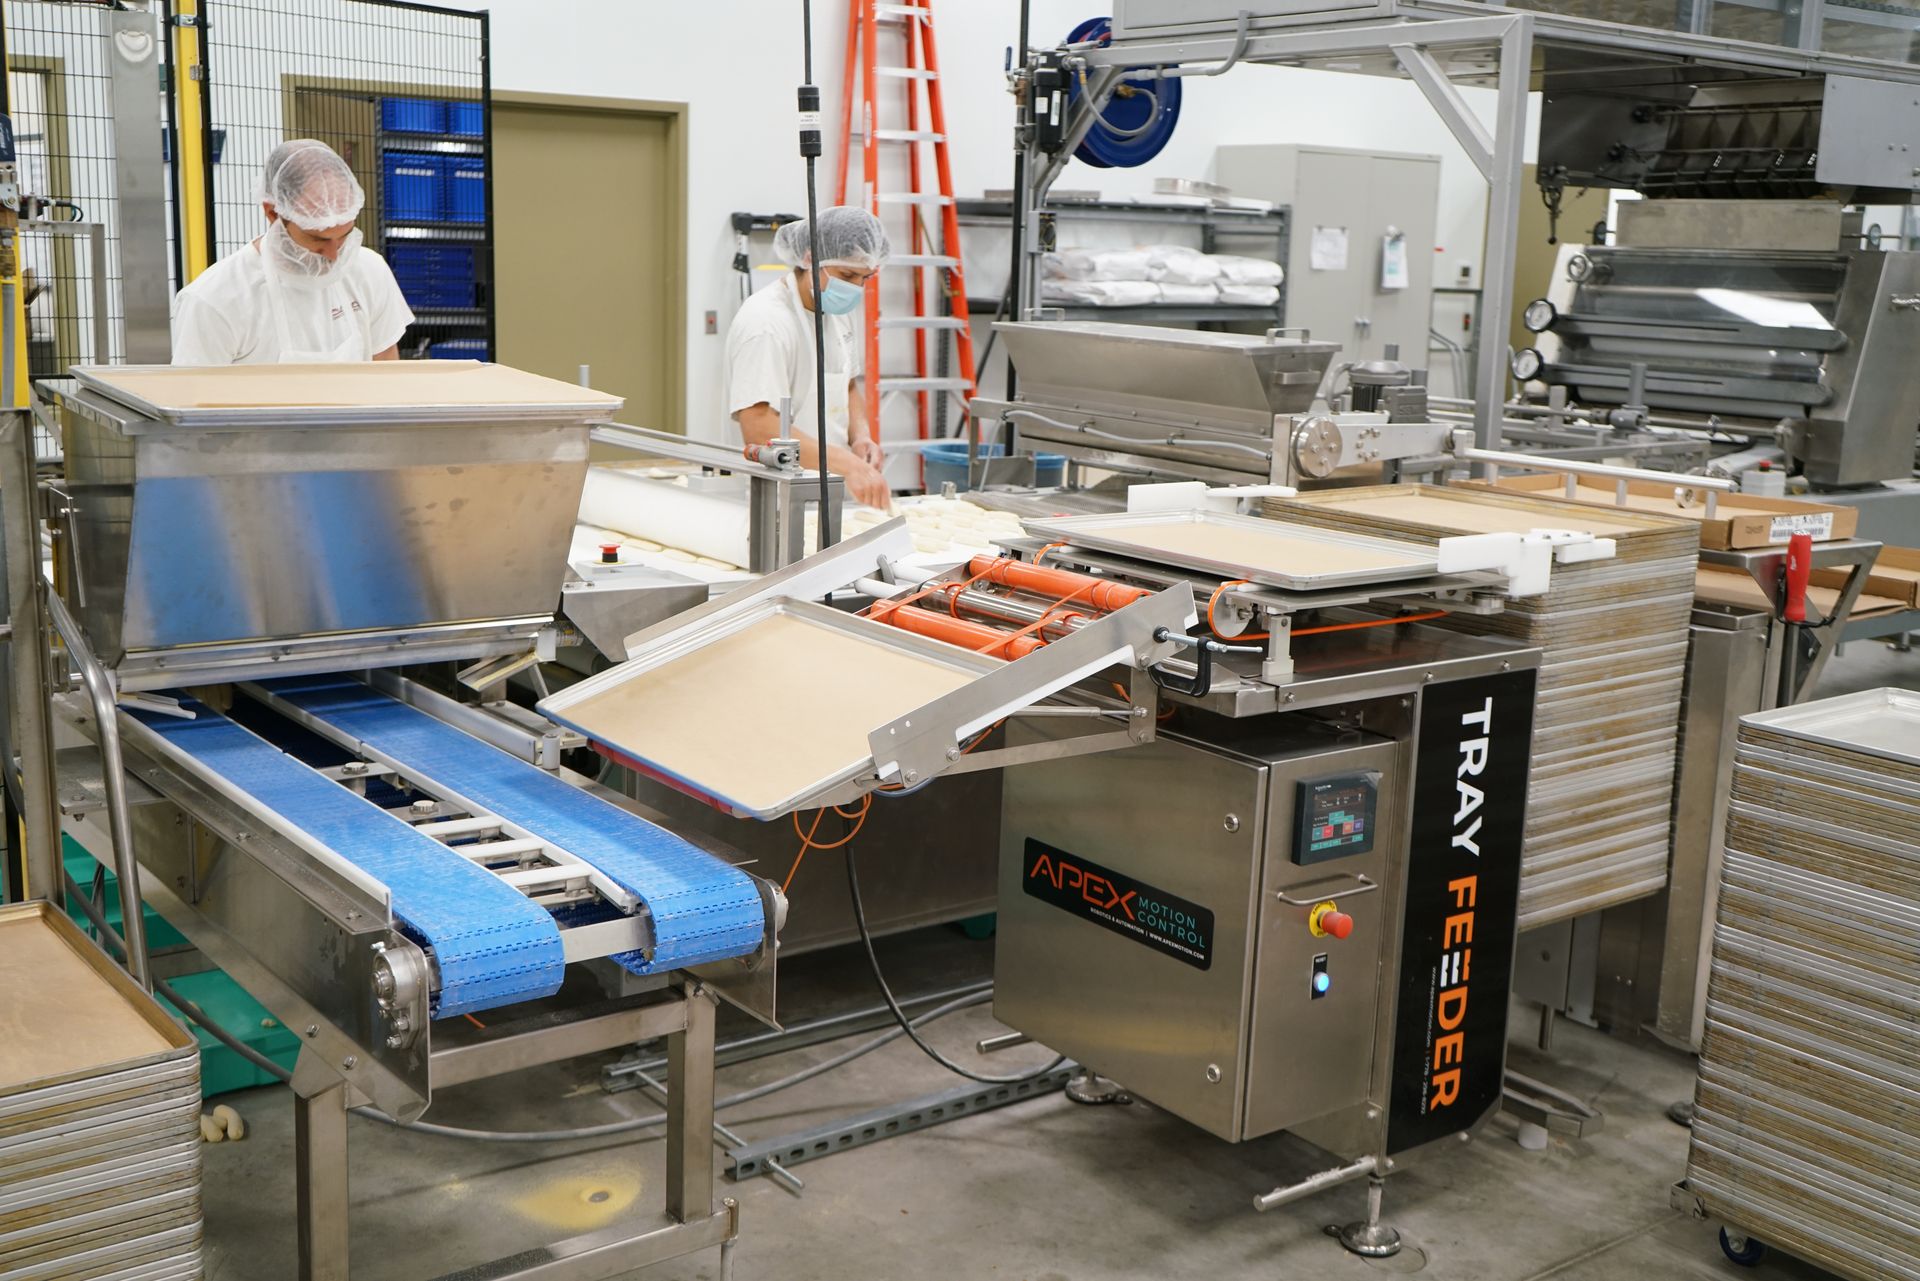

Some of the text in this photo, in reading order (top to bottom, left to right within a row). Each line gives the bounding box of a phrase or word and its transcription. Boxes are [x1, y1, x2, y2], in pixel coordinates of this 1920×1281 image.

[1030, 854, 1137, 921] APEX
[1138, 896, 1196, 930] MOTION
[1430, 696, 1493, 1112] TRAY FEEDER
[1090, 906, 1112, 921] ROBOTICS
[1115, 918, 1144, 936] AUTOMATION
[1149, 932, 1205, 960] WWW.APEXMOTION.COM
[1137, 911, 1206, 948] CONTROL
